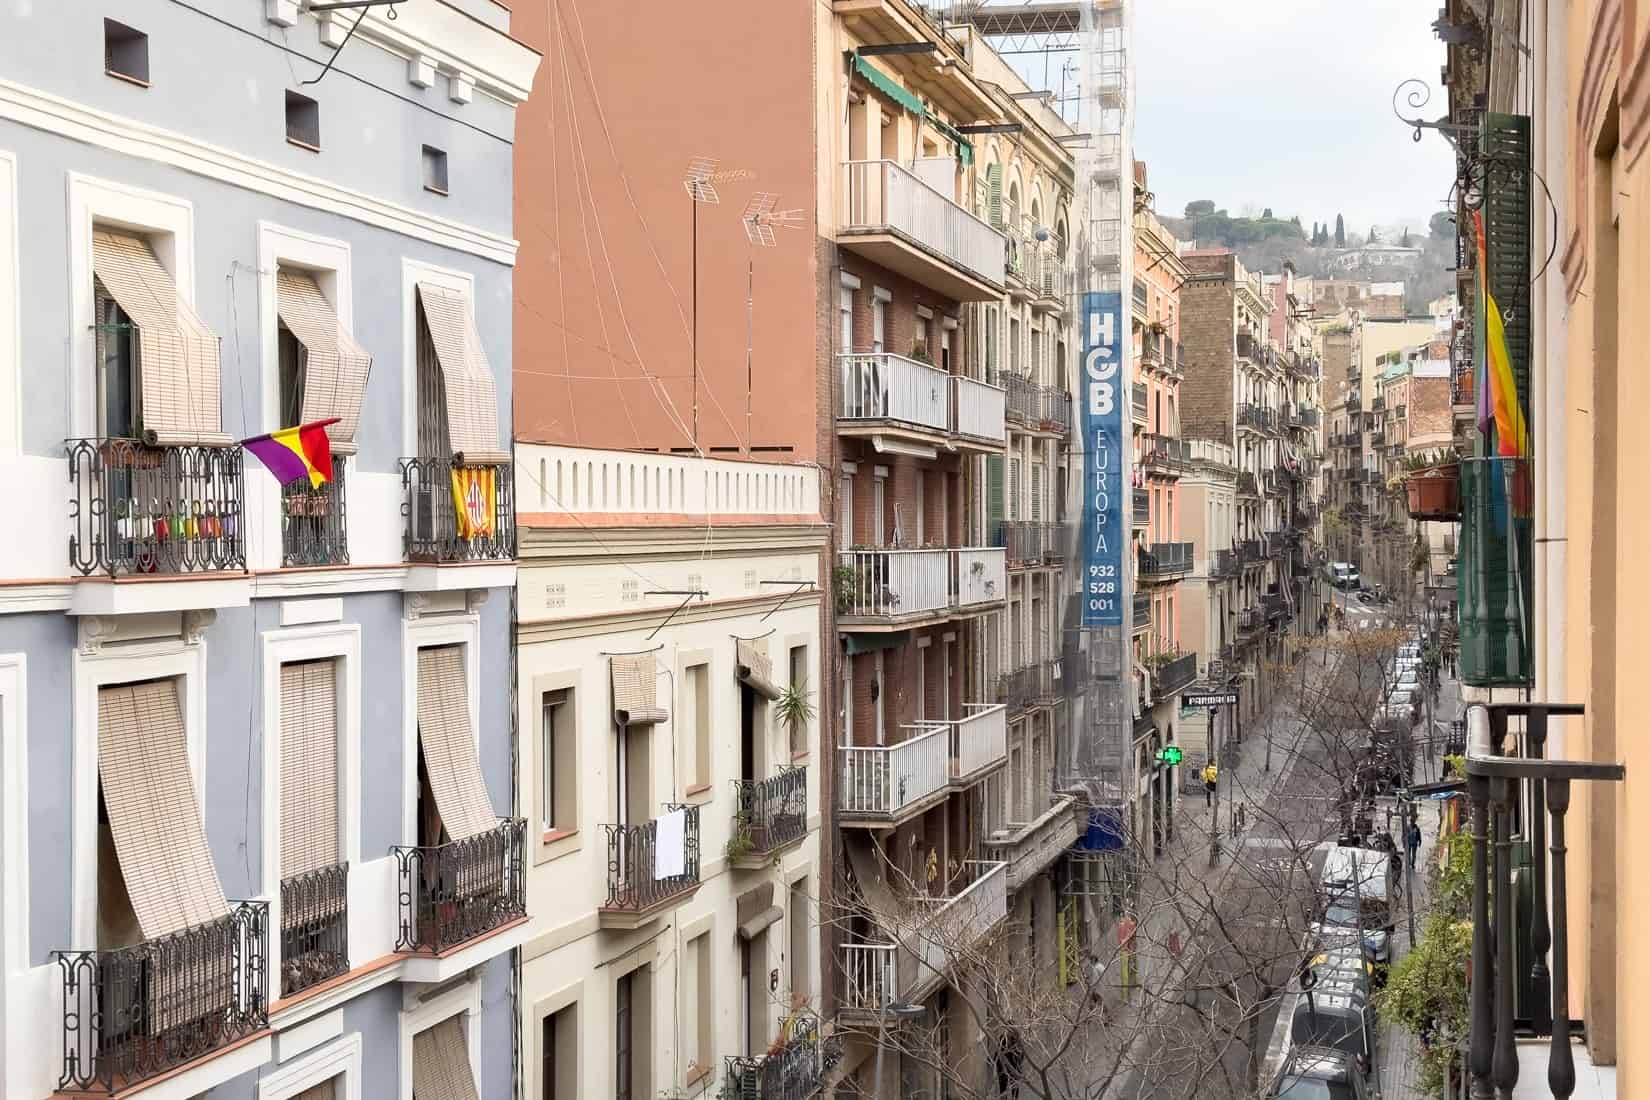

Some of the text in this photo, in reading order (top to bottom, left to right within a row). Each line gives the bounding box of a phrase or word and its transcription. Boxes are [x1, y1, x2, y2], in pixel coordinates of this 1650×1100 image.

[1086, 313, 1118, 553] HGB EUROPA
[1090, 565, 1115, 577] 932
[1090, 582, 1115, 593] 528
[1090, 599, 1113, 610] 001
